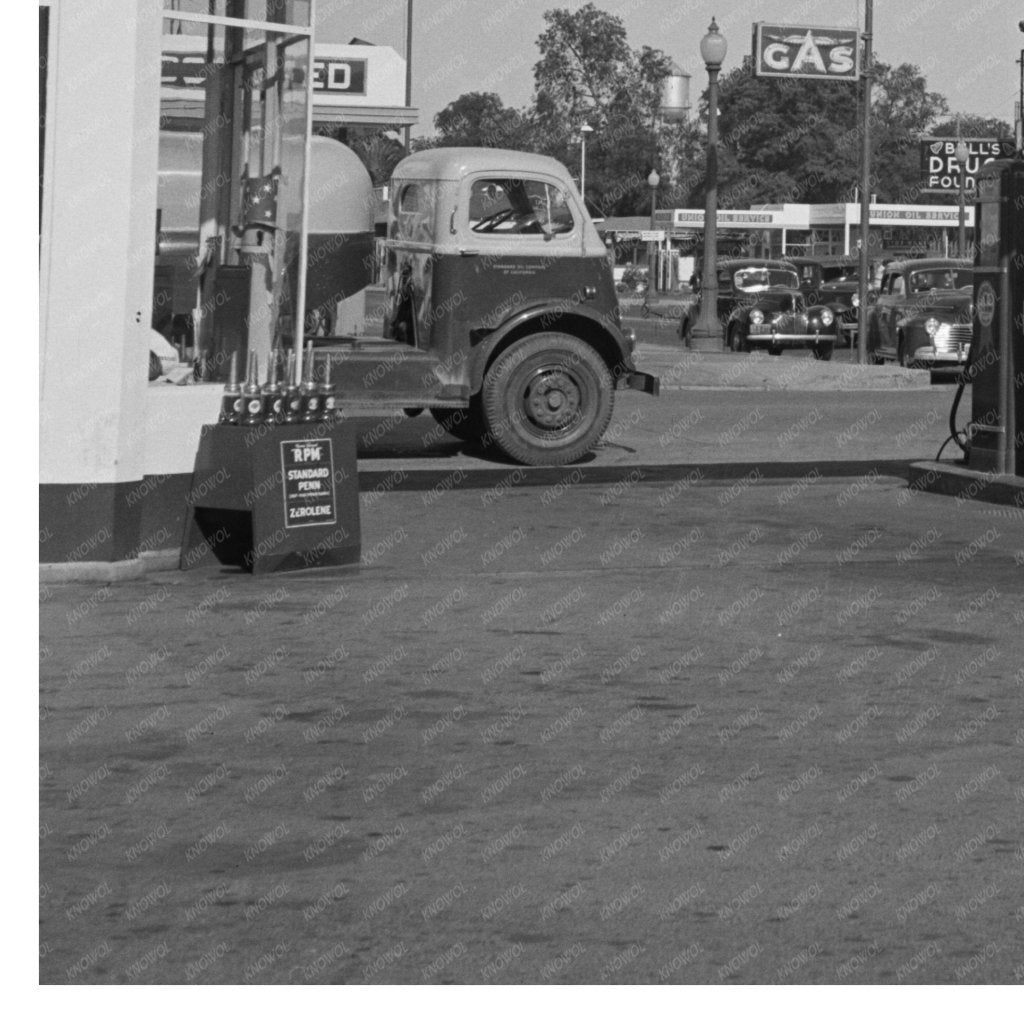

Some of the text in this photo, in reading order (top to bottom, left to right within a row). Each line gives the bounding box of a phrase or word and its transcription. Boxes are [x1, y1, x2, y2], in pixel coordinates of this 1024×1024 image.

[763, 29, 854, 74] GAS
[945, 142, 1000, 155] BLL'S
[292, 447, 322, 463] RPM
[288, 467, 329, 481] STANDARD
[298, 480, 321, 491] PENN
